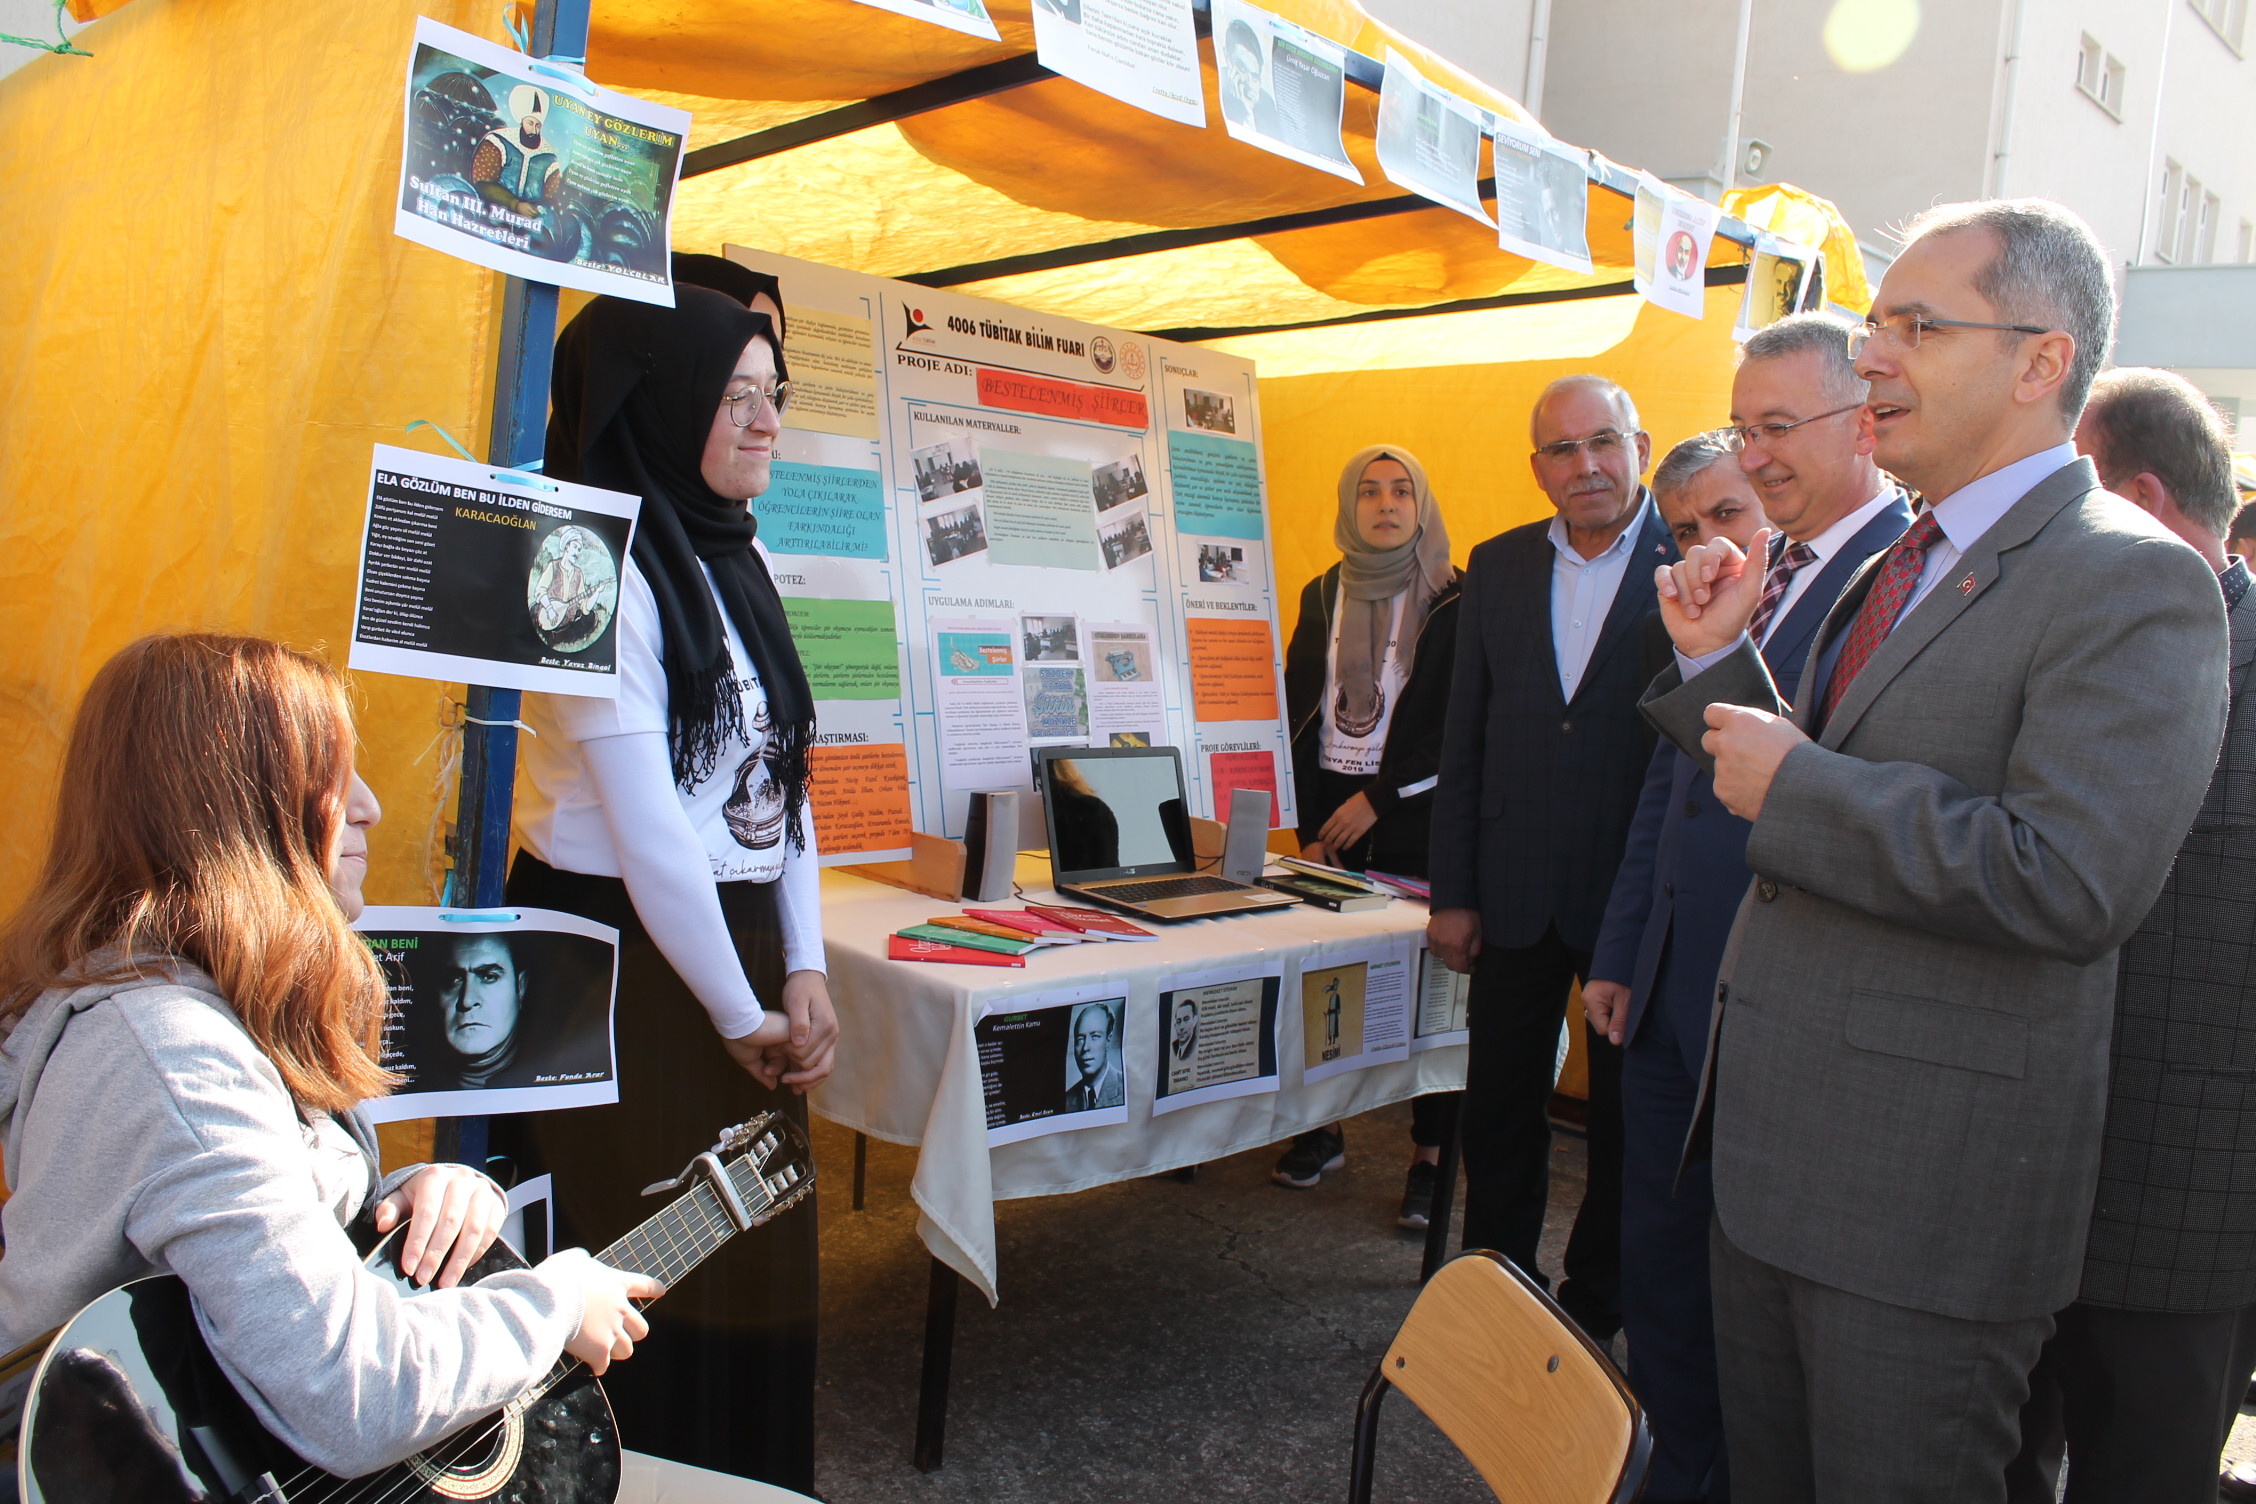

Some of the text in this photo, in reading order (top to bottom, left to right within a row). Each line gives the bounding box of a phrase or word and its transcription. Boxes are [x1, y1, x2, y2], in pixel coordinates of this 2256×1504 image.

[554, 95, 674, 147] UYAN EY GÖZLERİM
[410, 174, 542, 232] Sultan III. Murad
[416, 198, 531, 250] Han Hazretleri
[947, 315, 1085, 357] 4006 TÜBİTAK BİLİM FUARI
[897, 353, 973, 376] PROJE ADI:
[982, 376, 1084, 412] BESTELENMİŞ
[913, 411, 1022, 435] KULLANILAN MATERYALLER:
[770, 470, 878, 488] STELENMİŞ ŞİİRLERDEN
[377, 472, 572, 520] ELA GÖZLÜM BEN BU İLDEN GİDERSEM
[782, 487, 806, 498] YOLA
[455, 506, 537, 531] KARACAOĞLAN
[758, 500, 830, 517] ÖĞRENCİLERİN
[856, 511, 881, 521] OLAN
[774, 573, 806, 585] POTEZ:
[928, 596, 1015, 609] UYGULAMA ADIMLARI:
[1186, 599, 1205, 609] ÖNERİ
[1207, 601, 1214, 609] VE
[815, 733, 869, 745] RAŞTIRMASI:
[1201, 740, 1261, 754] PROJE GÖREVLİLERİ:
[391, 937, 418, 949] BENİ
[385, 952, 405, 961] Arif
[992, 1022, 1024, 1032] Kemalettin
